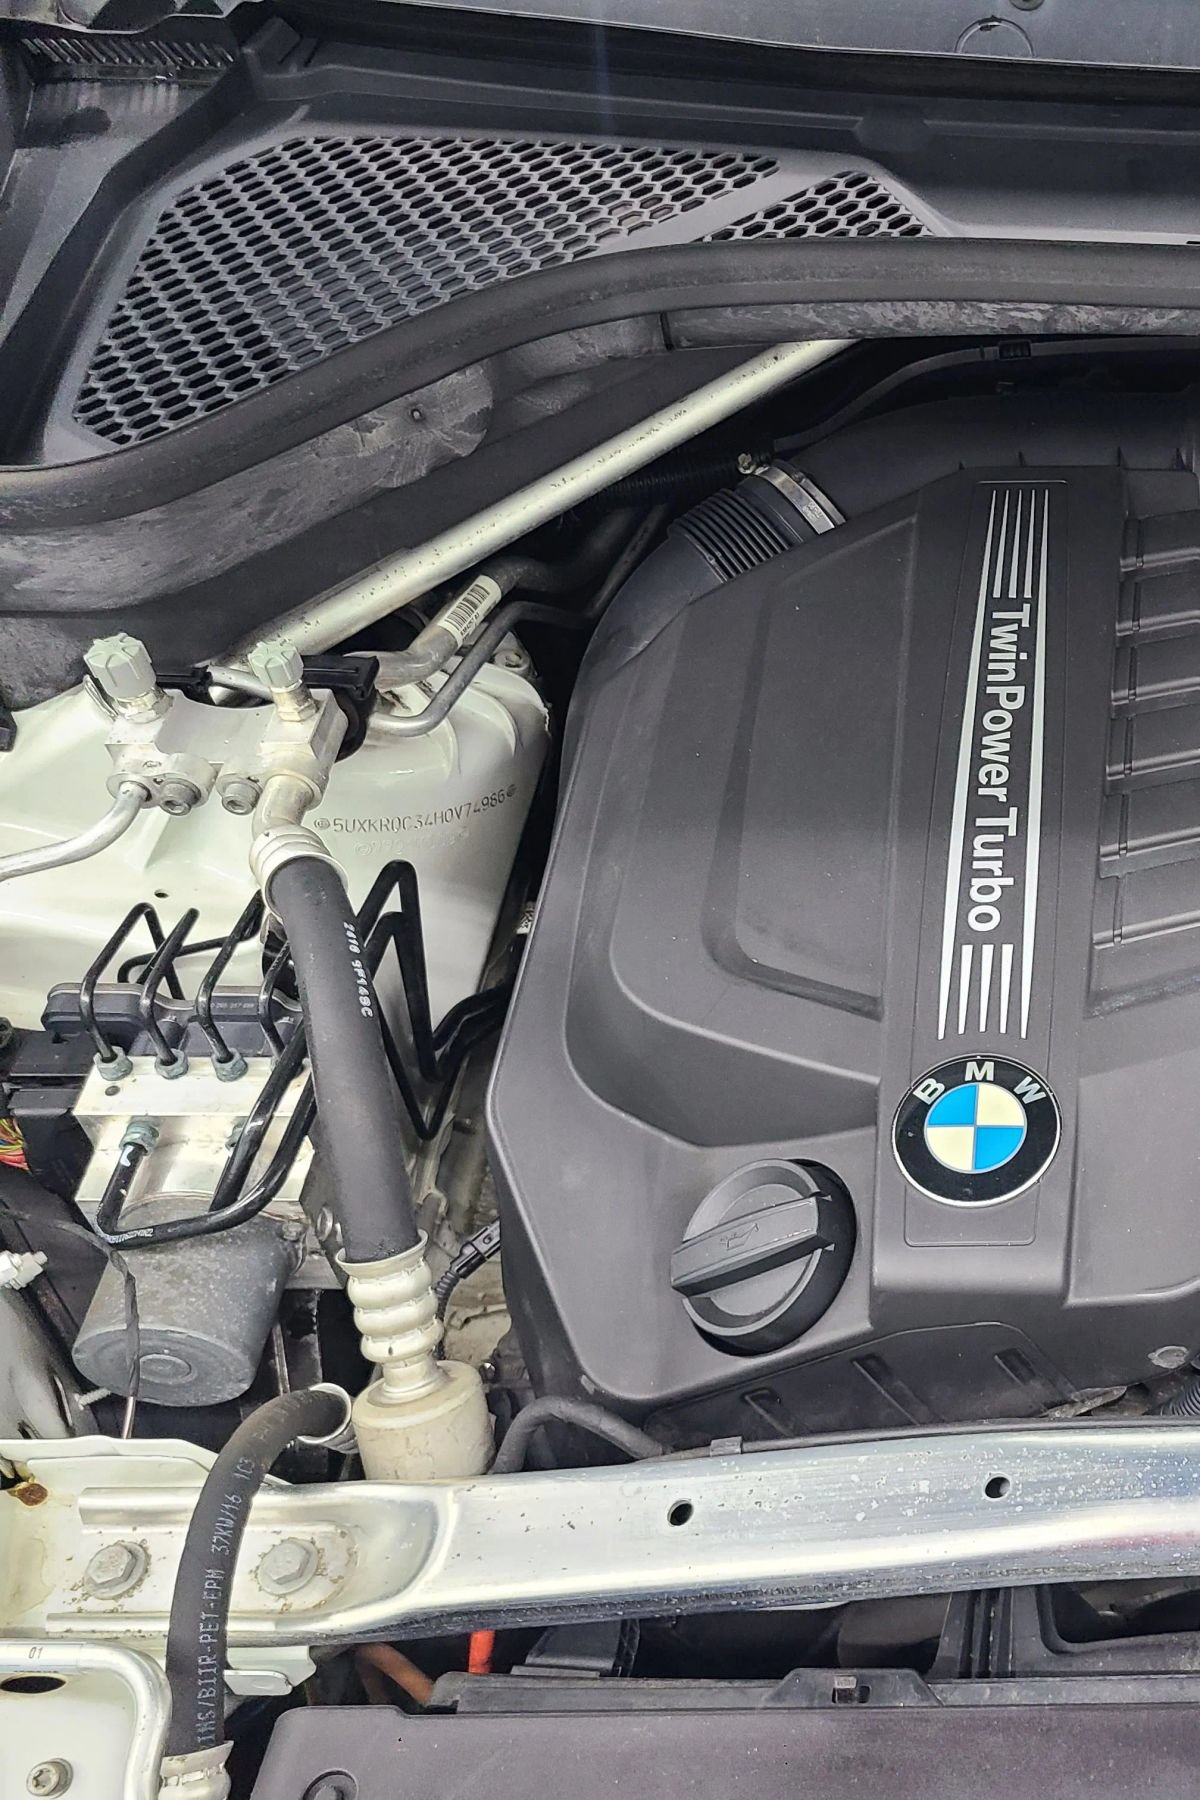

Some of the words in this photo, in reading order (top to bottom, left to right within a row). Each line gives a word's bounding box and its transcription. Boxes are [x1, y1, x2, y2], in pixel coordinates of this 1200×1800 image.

[977, 602, 1031, 803] TwinPower
[967, 806, 1019, 933] Turbo
[912, 1061, 1047, 1105] BMW
